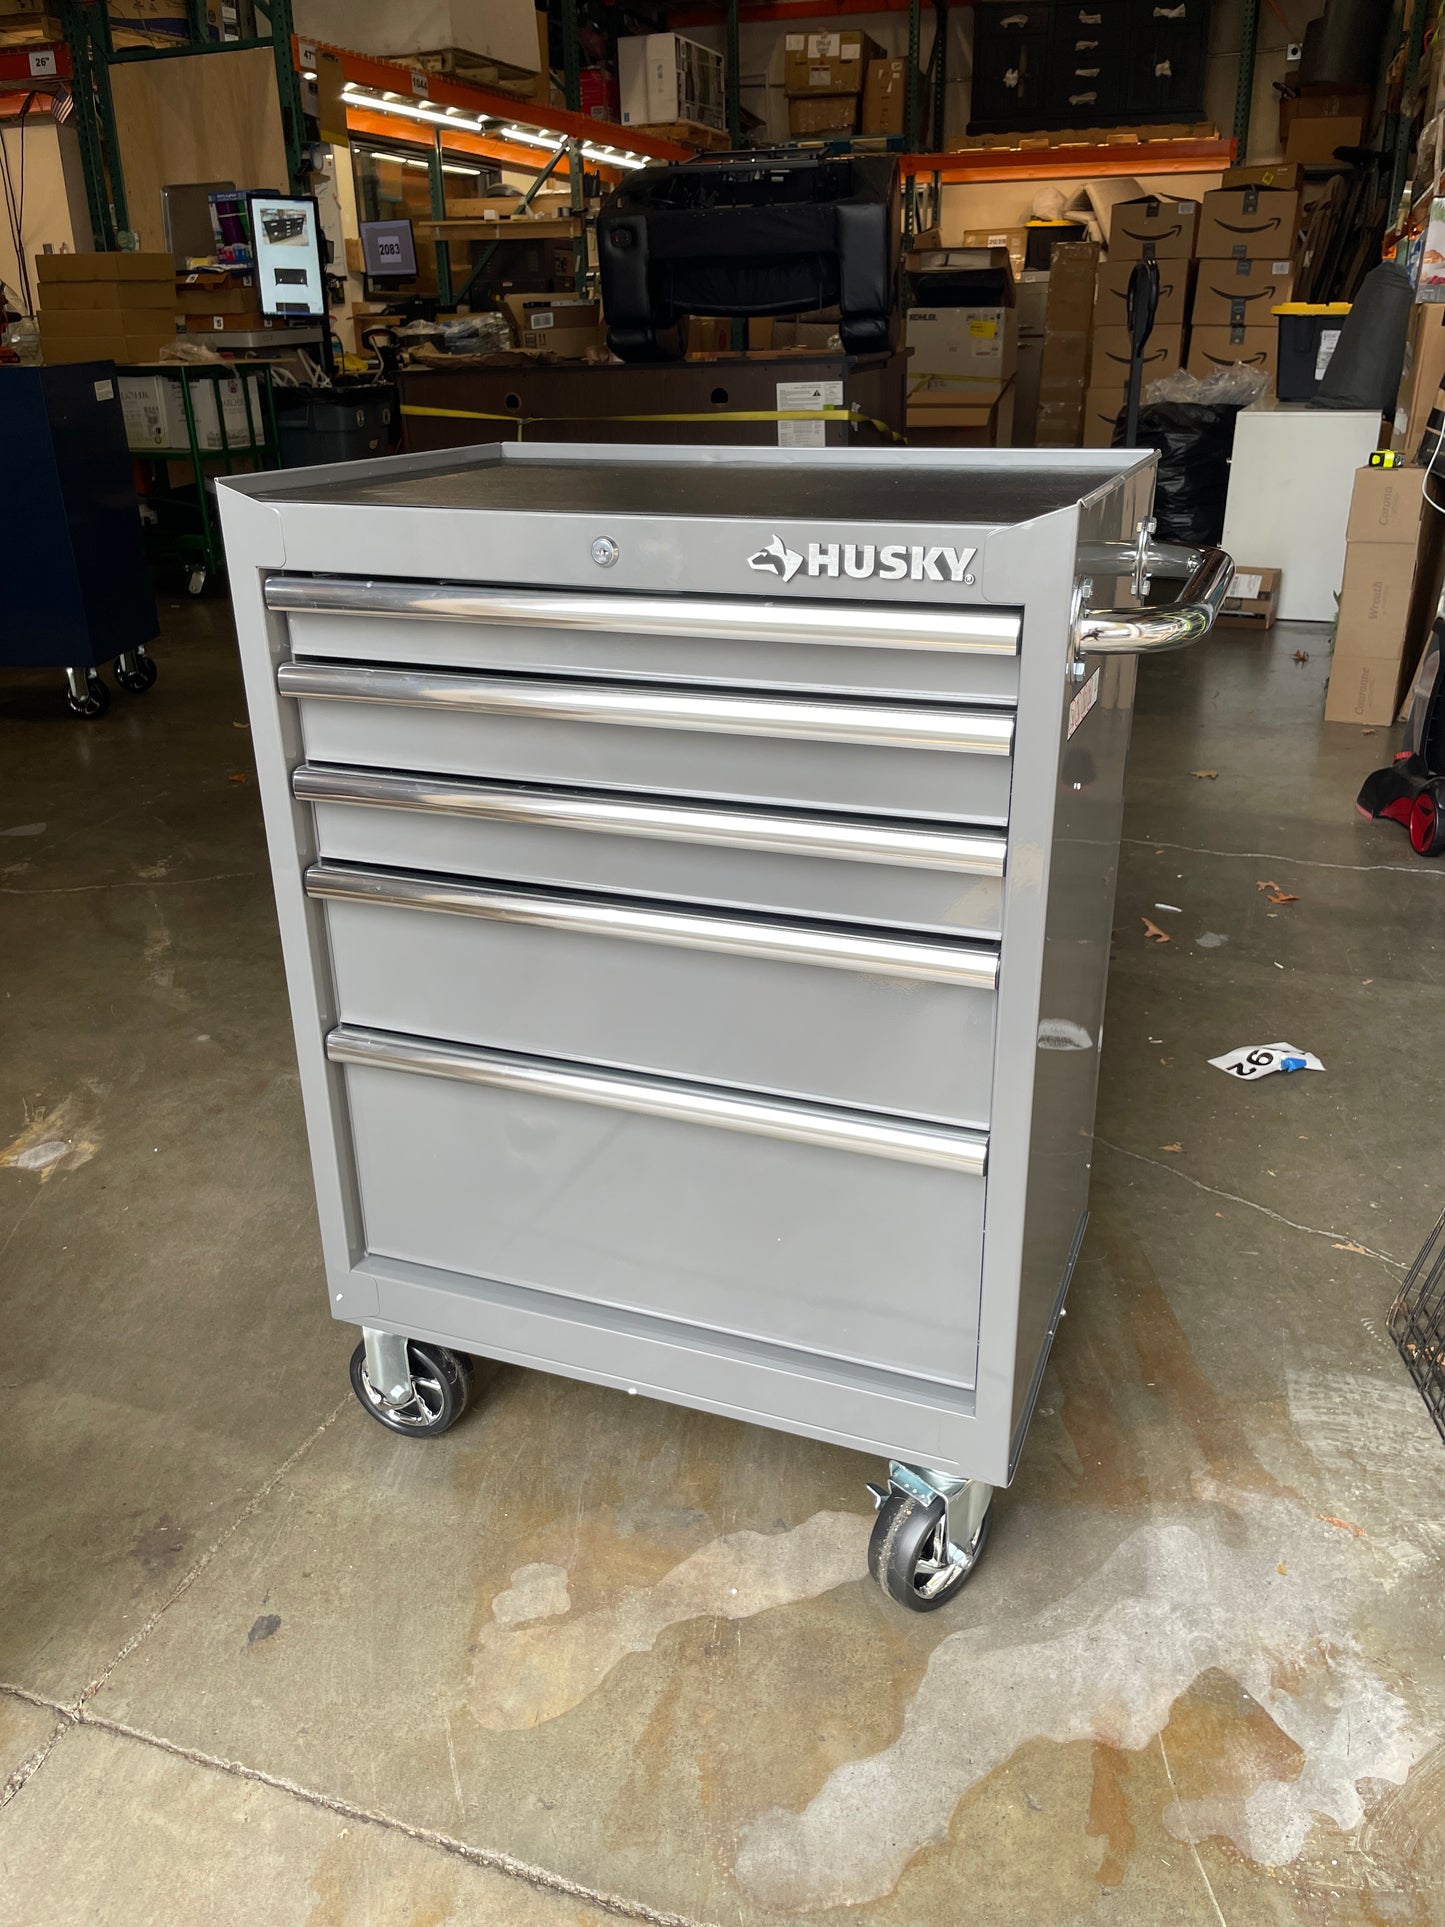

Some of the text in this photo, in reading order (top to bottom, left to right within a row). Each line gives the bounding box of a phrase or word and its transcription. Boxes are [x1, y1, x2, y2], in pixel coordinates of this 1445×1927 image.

[36, 57, 50, 67] 26"
[379, 243, 400, 255] 2083
[1378, 486, 1393, 526] Corona
[808, 543, 977, 582] HUSKY
[1368, 580, 1383, 621] Wreath
[1355, 667, 1370, 716] Couronne
